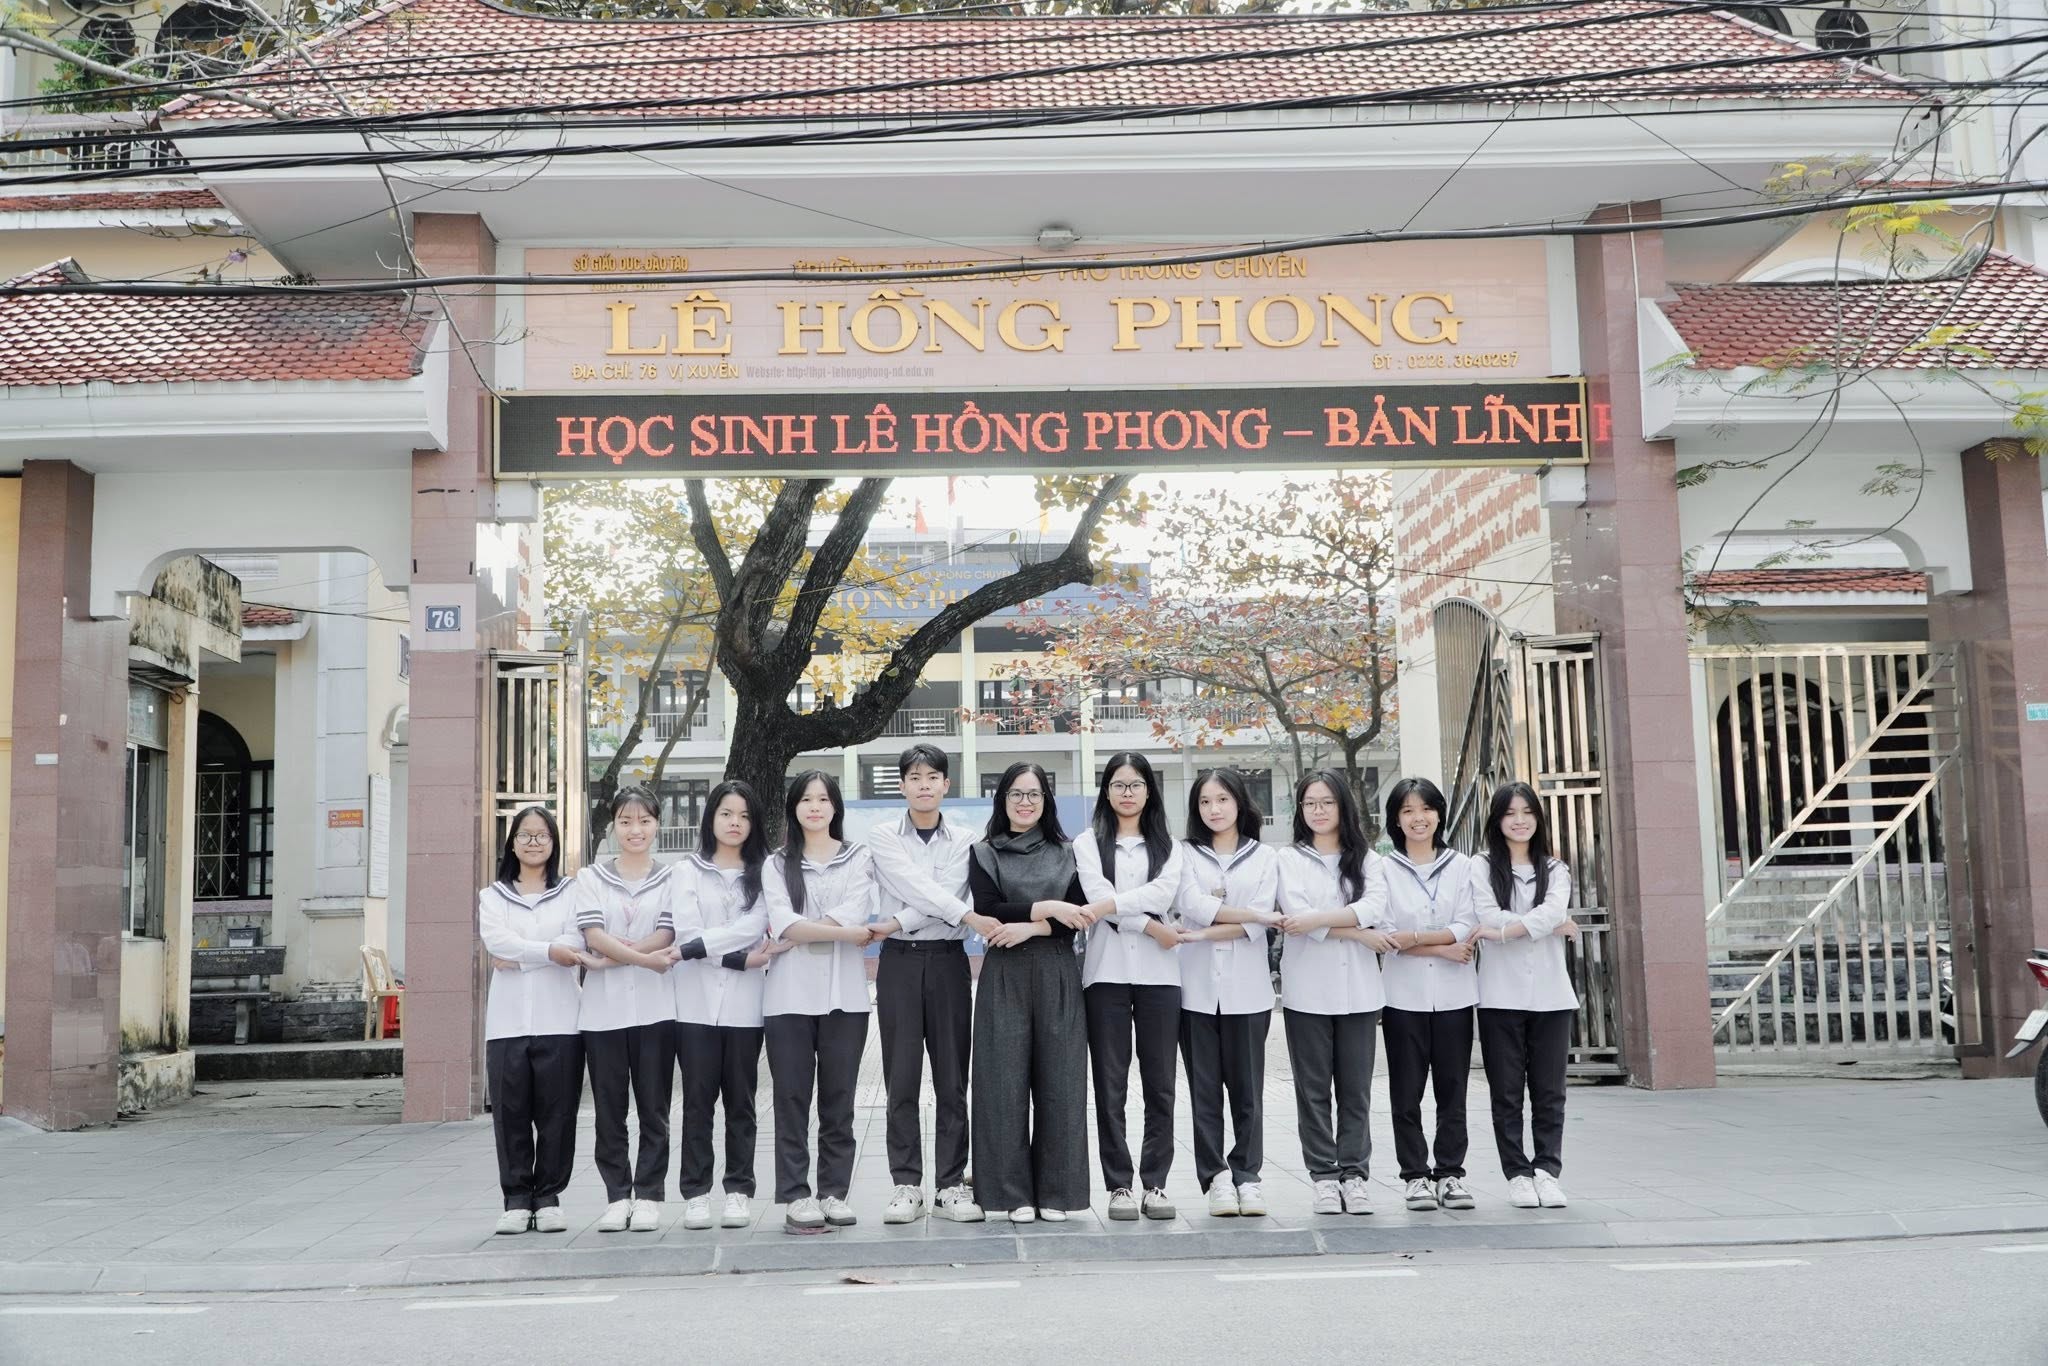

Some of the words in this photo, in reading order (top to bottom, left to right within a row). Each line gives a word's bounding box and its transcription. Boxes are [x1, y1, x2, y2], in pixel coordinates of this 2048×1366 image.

[1213, 251, 1308, 279] CHUYÊN
[605, 289, 733, 355] LÊ
[777, 287, 1071, 355] HỒNG
[1111, 292, 1464, 351] PHONG
[572, 363, 597, 382] ĐỊA
[640, 364, 657, 380] 76
[668, 363, 683, 382] VỊ
[688, 357, 739, 379] XUYÊN
[746, 366, 785, 379] Website:
[1371, 354, 1393, 369] ĐT
[556, 415, 674, 465] HỌC
[691, 415, 818, 457] SINH
[830, 403, 899, 455] LÊ
[911, 401, 1070, 454] HỒNG
[1083, 408, 1271, 452] PHONG
[1324, 394, 1439, 447] BẢN
[1452, 394, 1582, 446] LĨNH
[431, 610, 455, 629] 76
